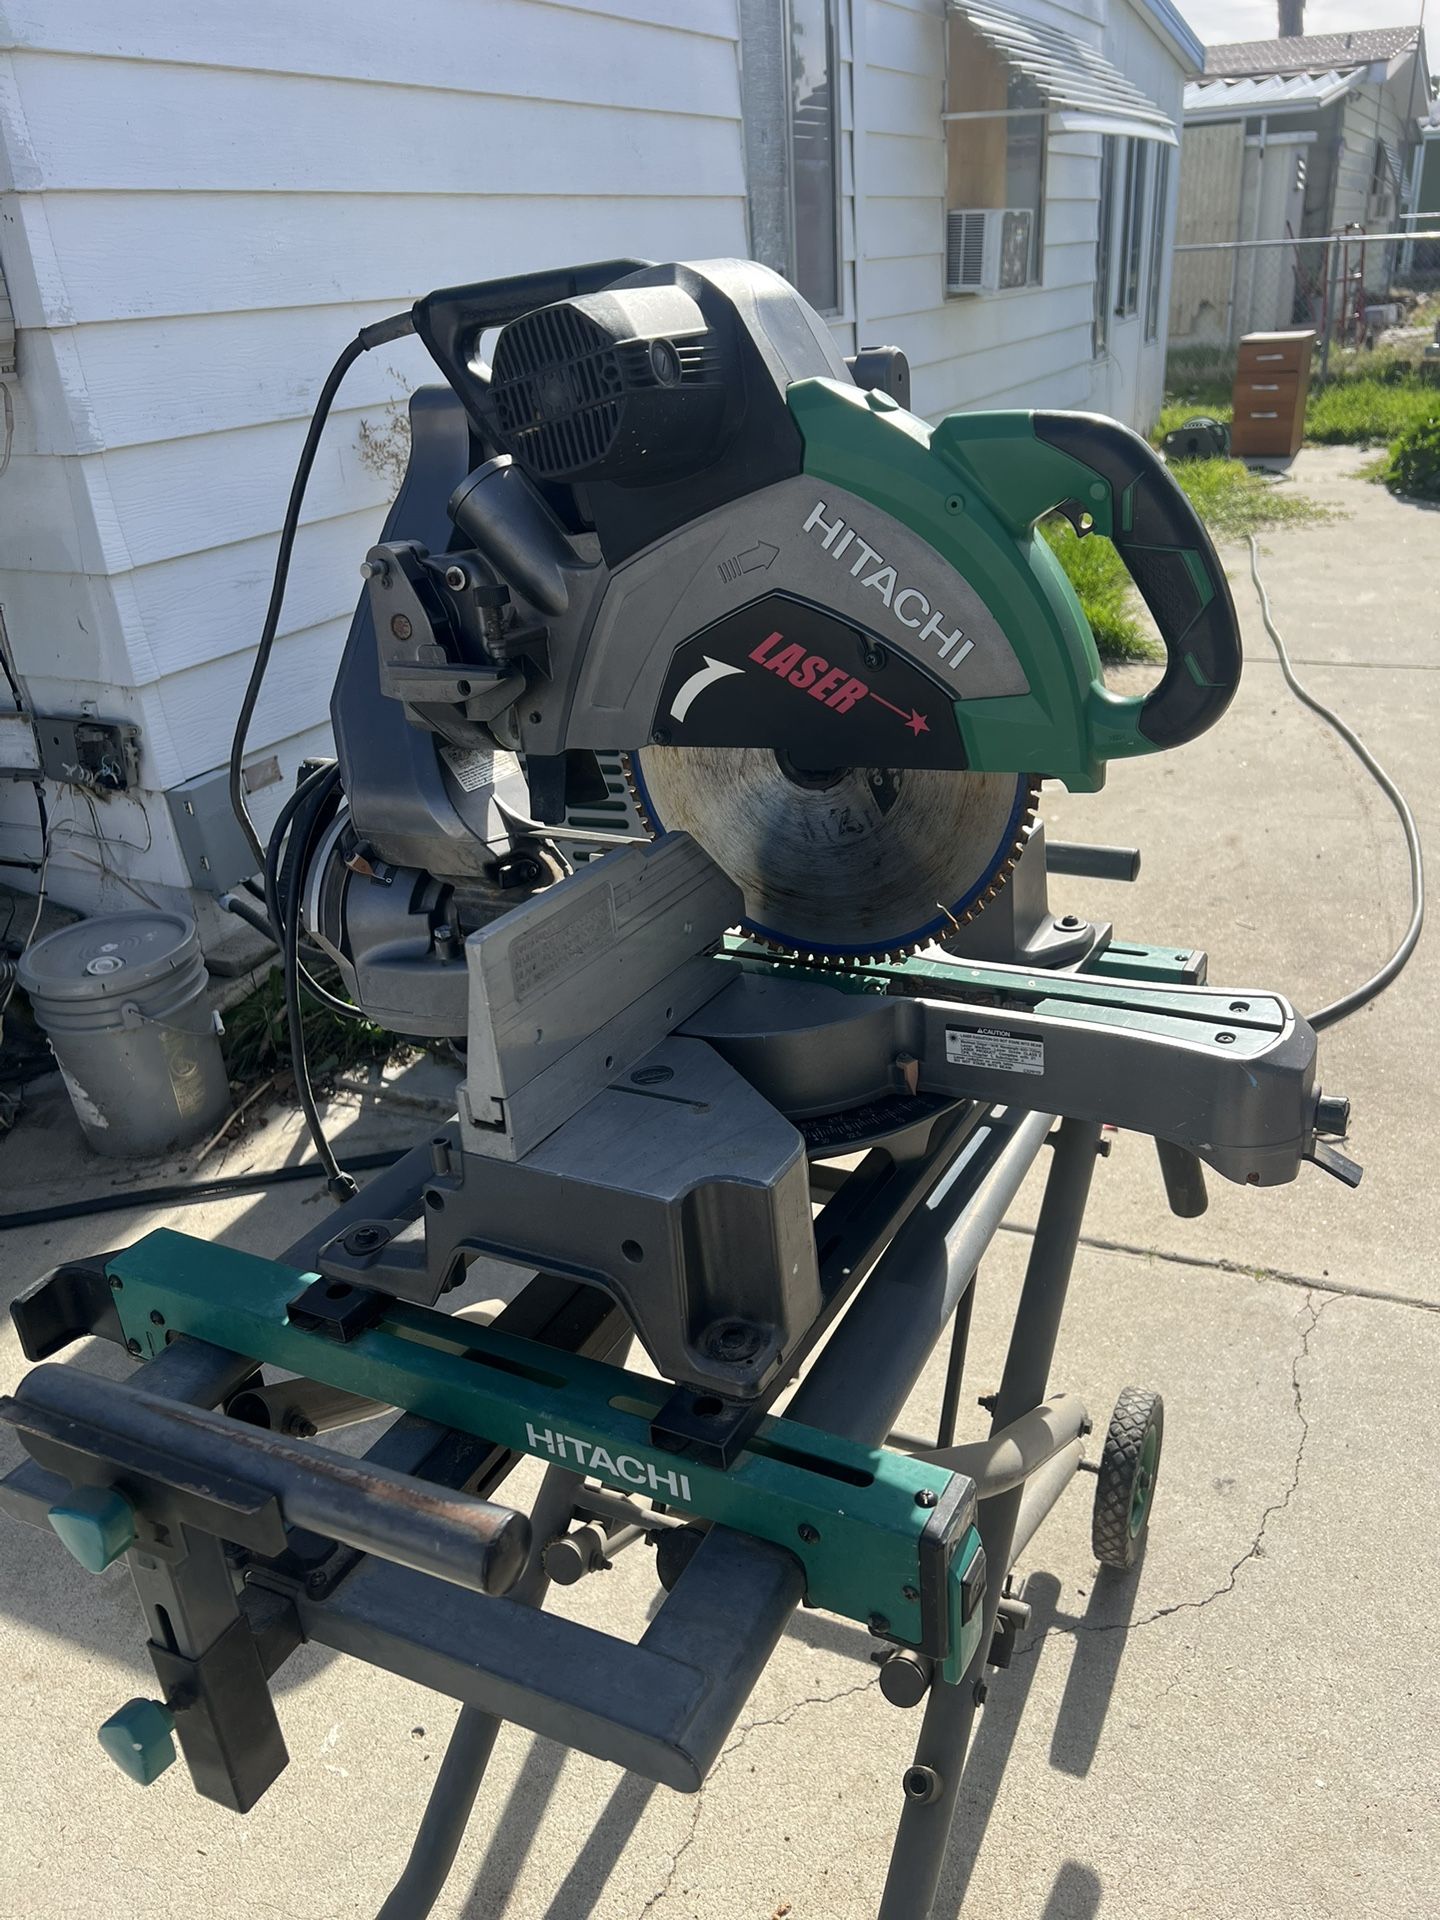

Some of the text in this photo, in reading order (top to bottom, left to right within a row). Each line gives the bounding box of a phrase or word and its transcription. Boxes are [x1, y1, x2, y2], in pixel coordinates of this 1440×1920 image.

[802, 500, 976, 670] HITACHI
[748, 631, 869, 714] LASER
[983, 1028, 1011, 1037] CAUTION
[525, 1422, 692, 1501] HITACHI
